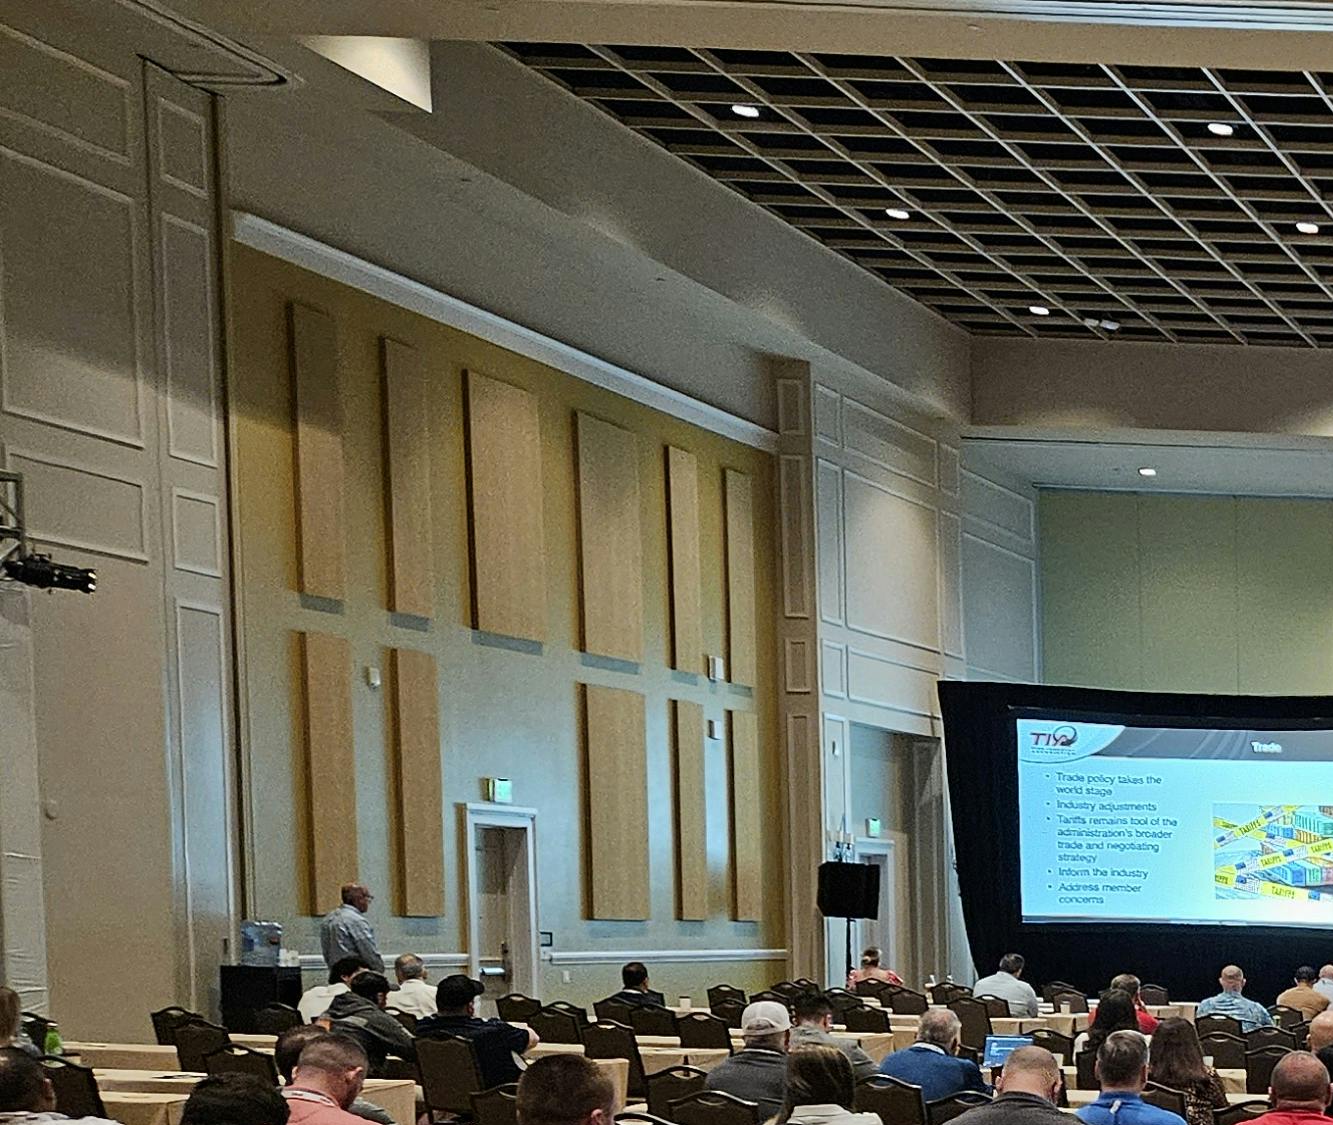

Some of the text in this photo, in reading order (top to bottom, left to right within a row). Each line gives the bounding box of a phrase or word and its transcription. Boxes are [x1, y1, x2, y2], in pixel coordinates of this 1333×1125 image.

[1251, 741, 1282, 754] Trade
[1056, 772, 1162, 785] Trade policy takes the
[1056, 786, 1113, 797] world stage
[1056, 800, 1157, 813] Industry adjustments
[1057, 814, 1178, 827] Tariffs remains tool of the
[1057, 828, 1173, 839] administration's broader
[1057, 841, 1160, 853] trade and negotiating
[1057, 853, 1098, 863] strategy
[1058, 867, 1149, 880] Inform the industry
[1058, 883, 1142, 893] Address member
[1058, 896, 1104, 904] concerns
